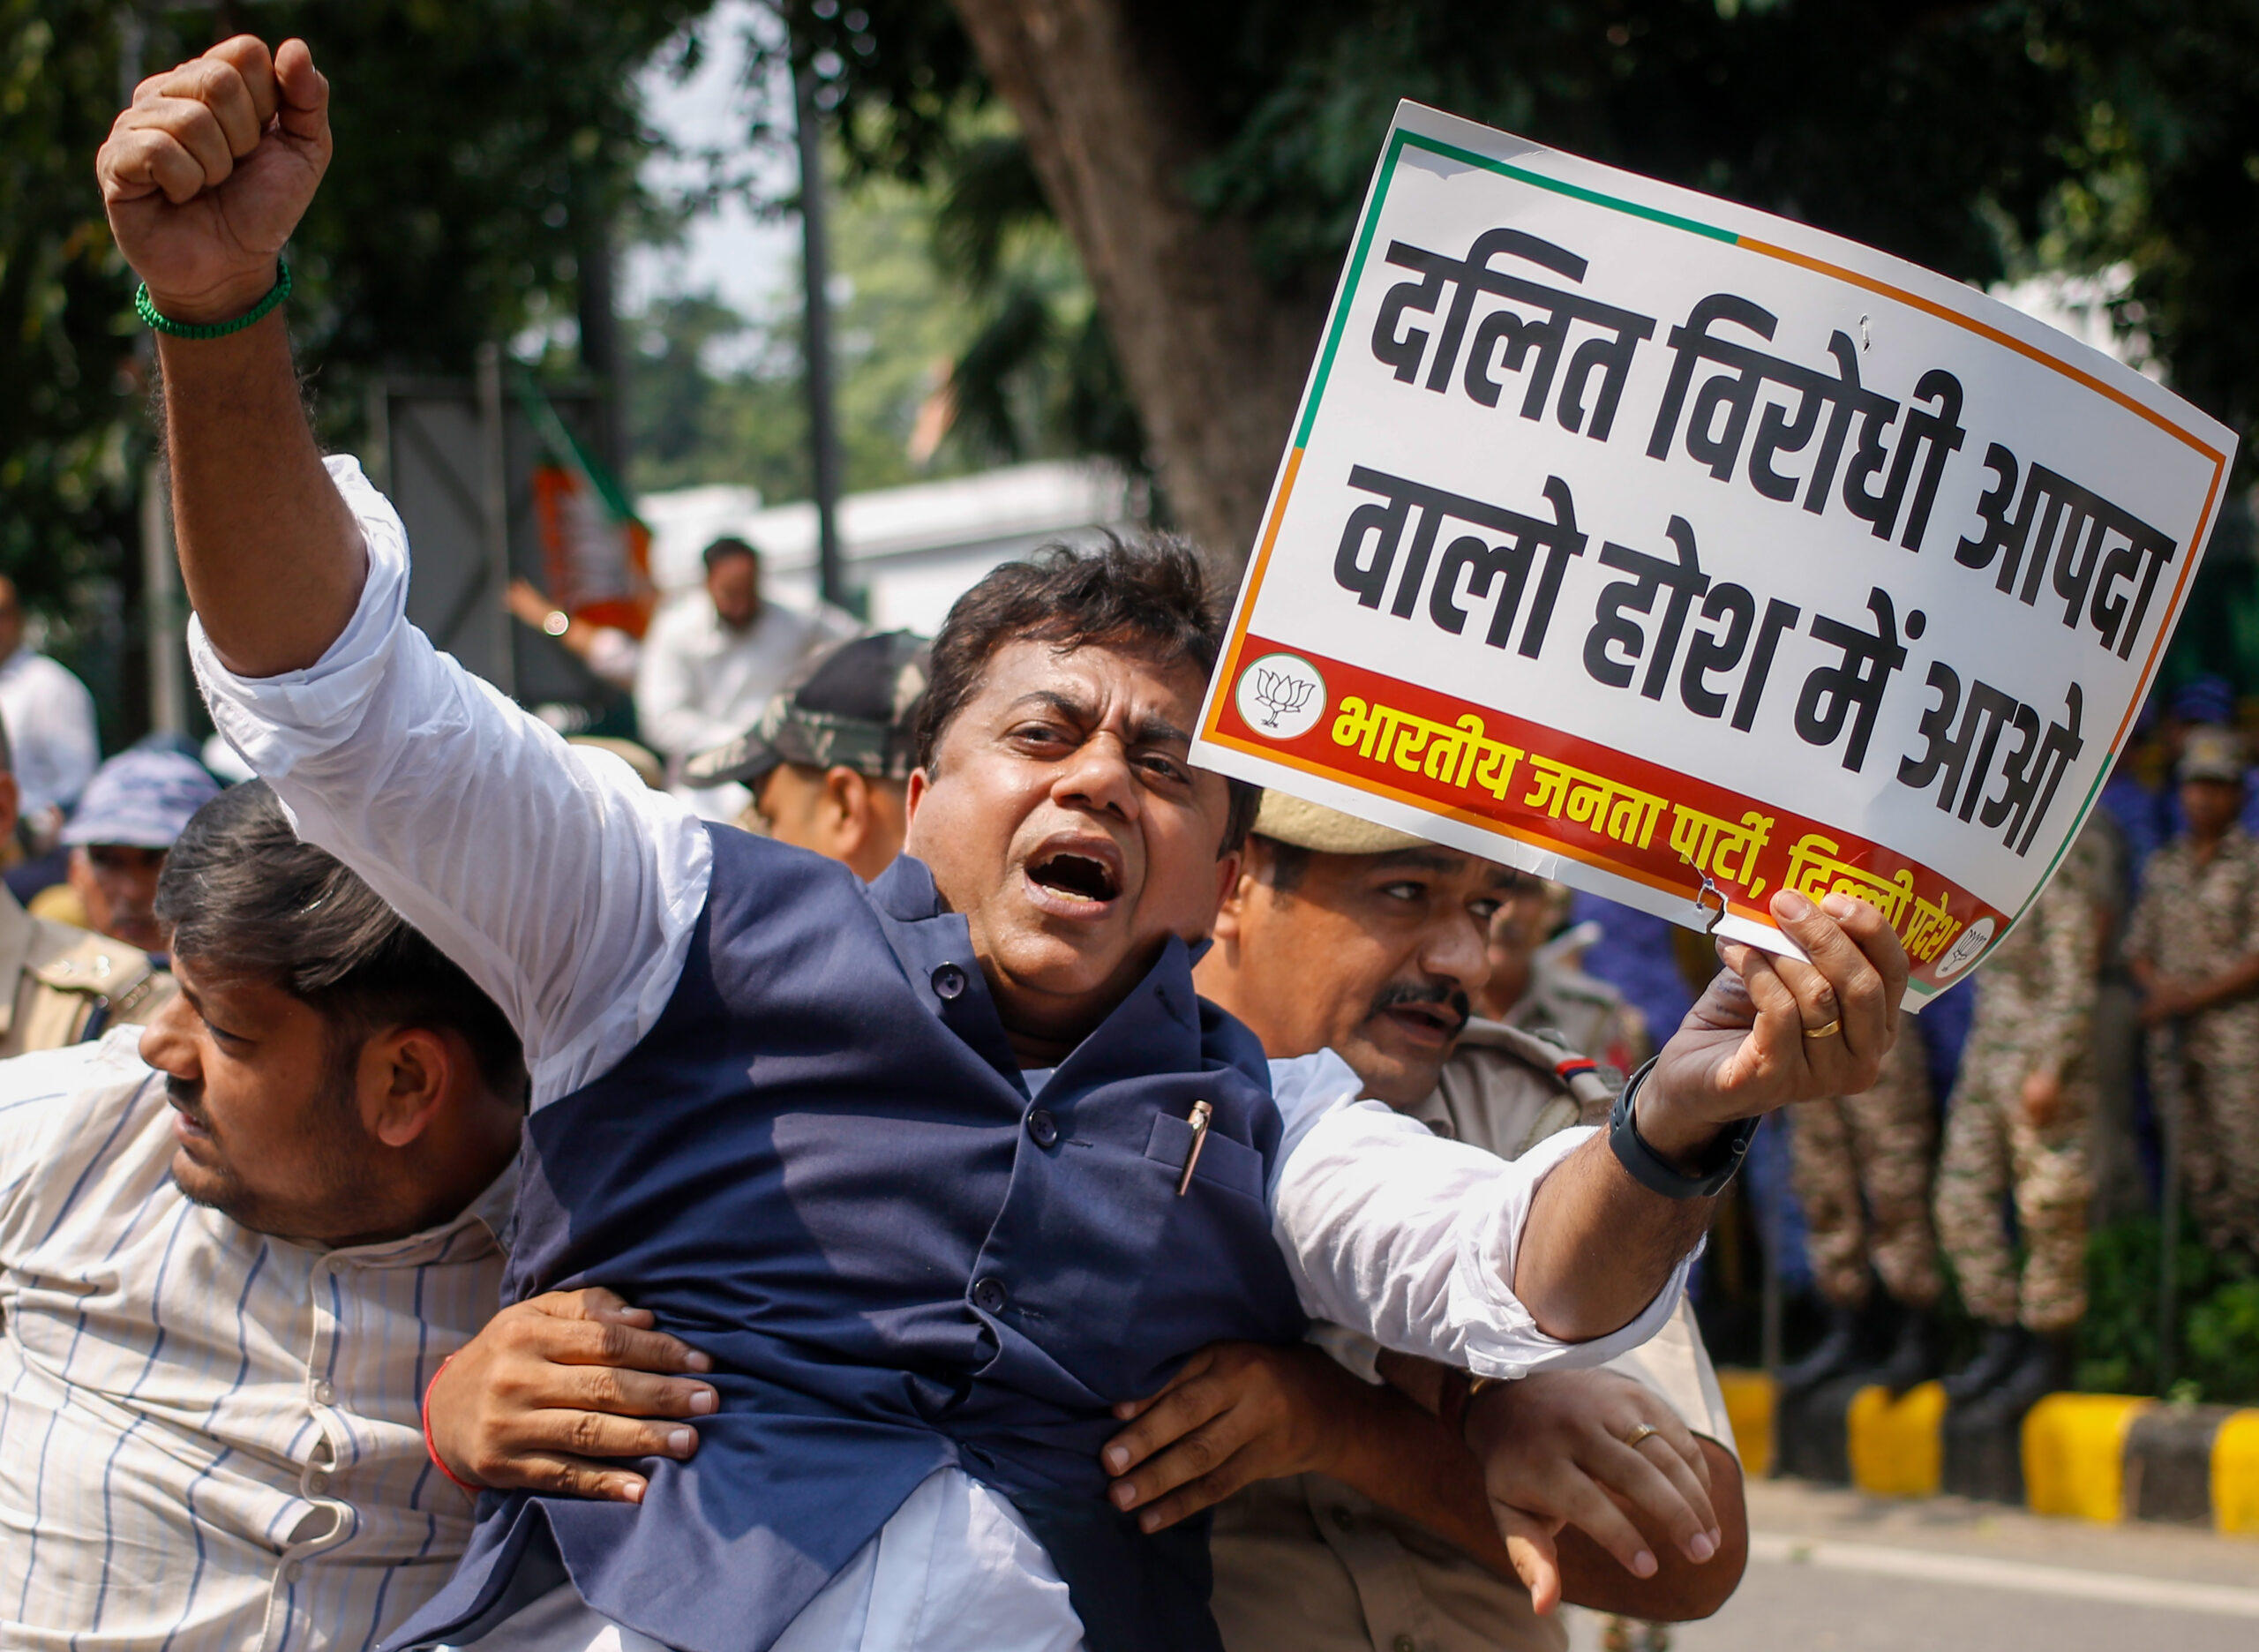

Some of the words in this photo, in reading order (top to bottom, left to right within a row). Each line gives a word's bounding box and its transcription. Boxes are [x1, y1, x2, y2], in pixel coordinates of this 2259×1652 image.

[1370, 228, 1657, 443] दलित
[1647, 293, 1967, 554] विरोधी
[1954, 441, 2178, 662] आपदा
[1332, 695, 1526, 800] भारतीय
[1524, 755, 1669, 850] जनता
[1670, 804, 1775, 899] पार्टी,
[1900, 890, 1963, 965] प्रदेश
[1333, 464, 1589, 660] वालो
[1583, 514, 1801, 734] होश
[1793, 586, 1927, 774] में
[1898, 658, 2084, 859] आओ
